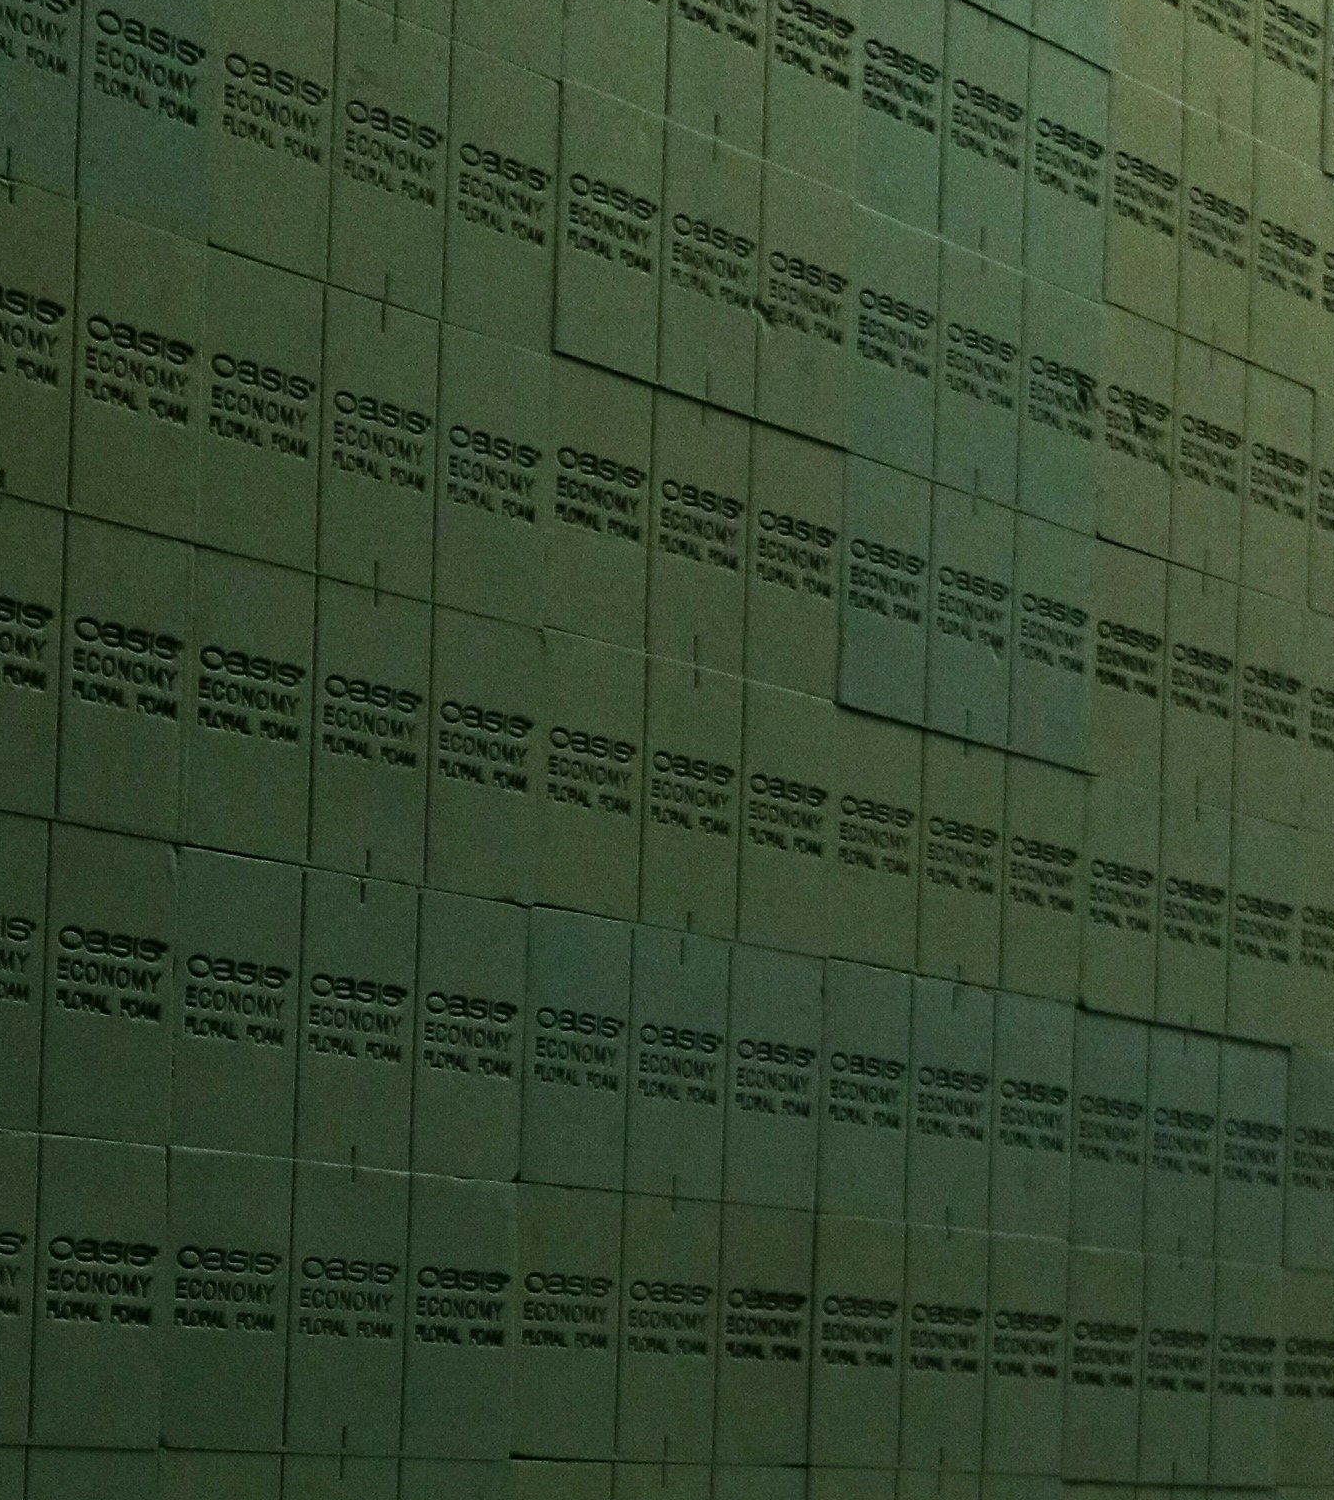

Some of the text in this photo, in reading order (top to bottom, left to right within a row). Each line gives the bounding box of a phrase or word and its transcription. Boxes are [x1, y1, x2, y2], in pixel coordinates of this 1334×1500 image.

[26, 46, 69, 78] FOAM
[346, 129, 436, 179] ECONOMY
[343, 159, 437, 207] FLORAL FOAM
[186, 986, 286, 1018] ECONOMY
[184, 1015, 286, 1046] FLORAL FOAM
[176, 1277, 276, 1304] ECONOMY
[173, 1307, 277, 1330] FLORAL FOAM
